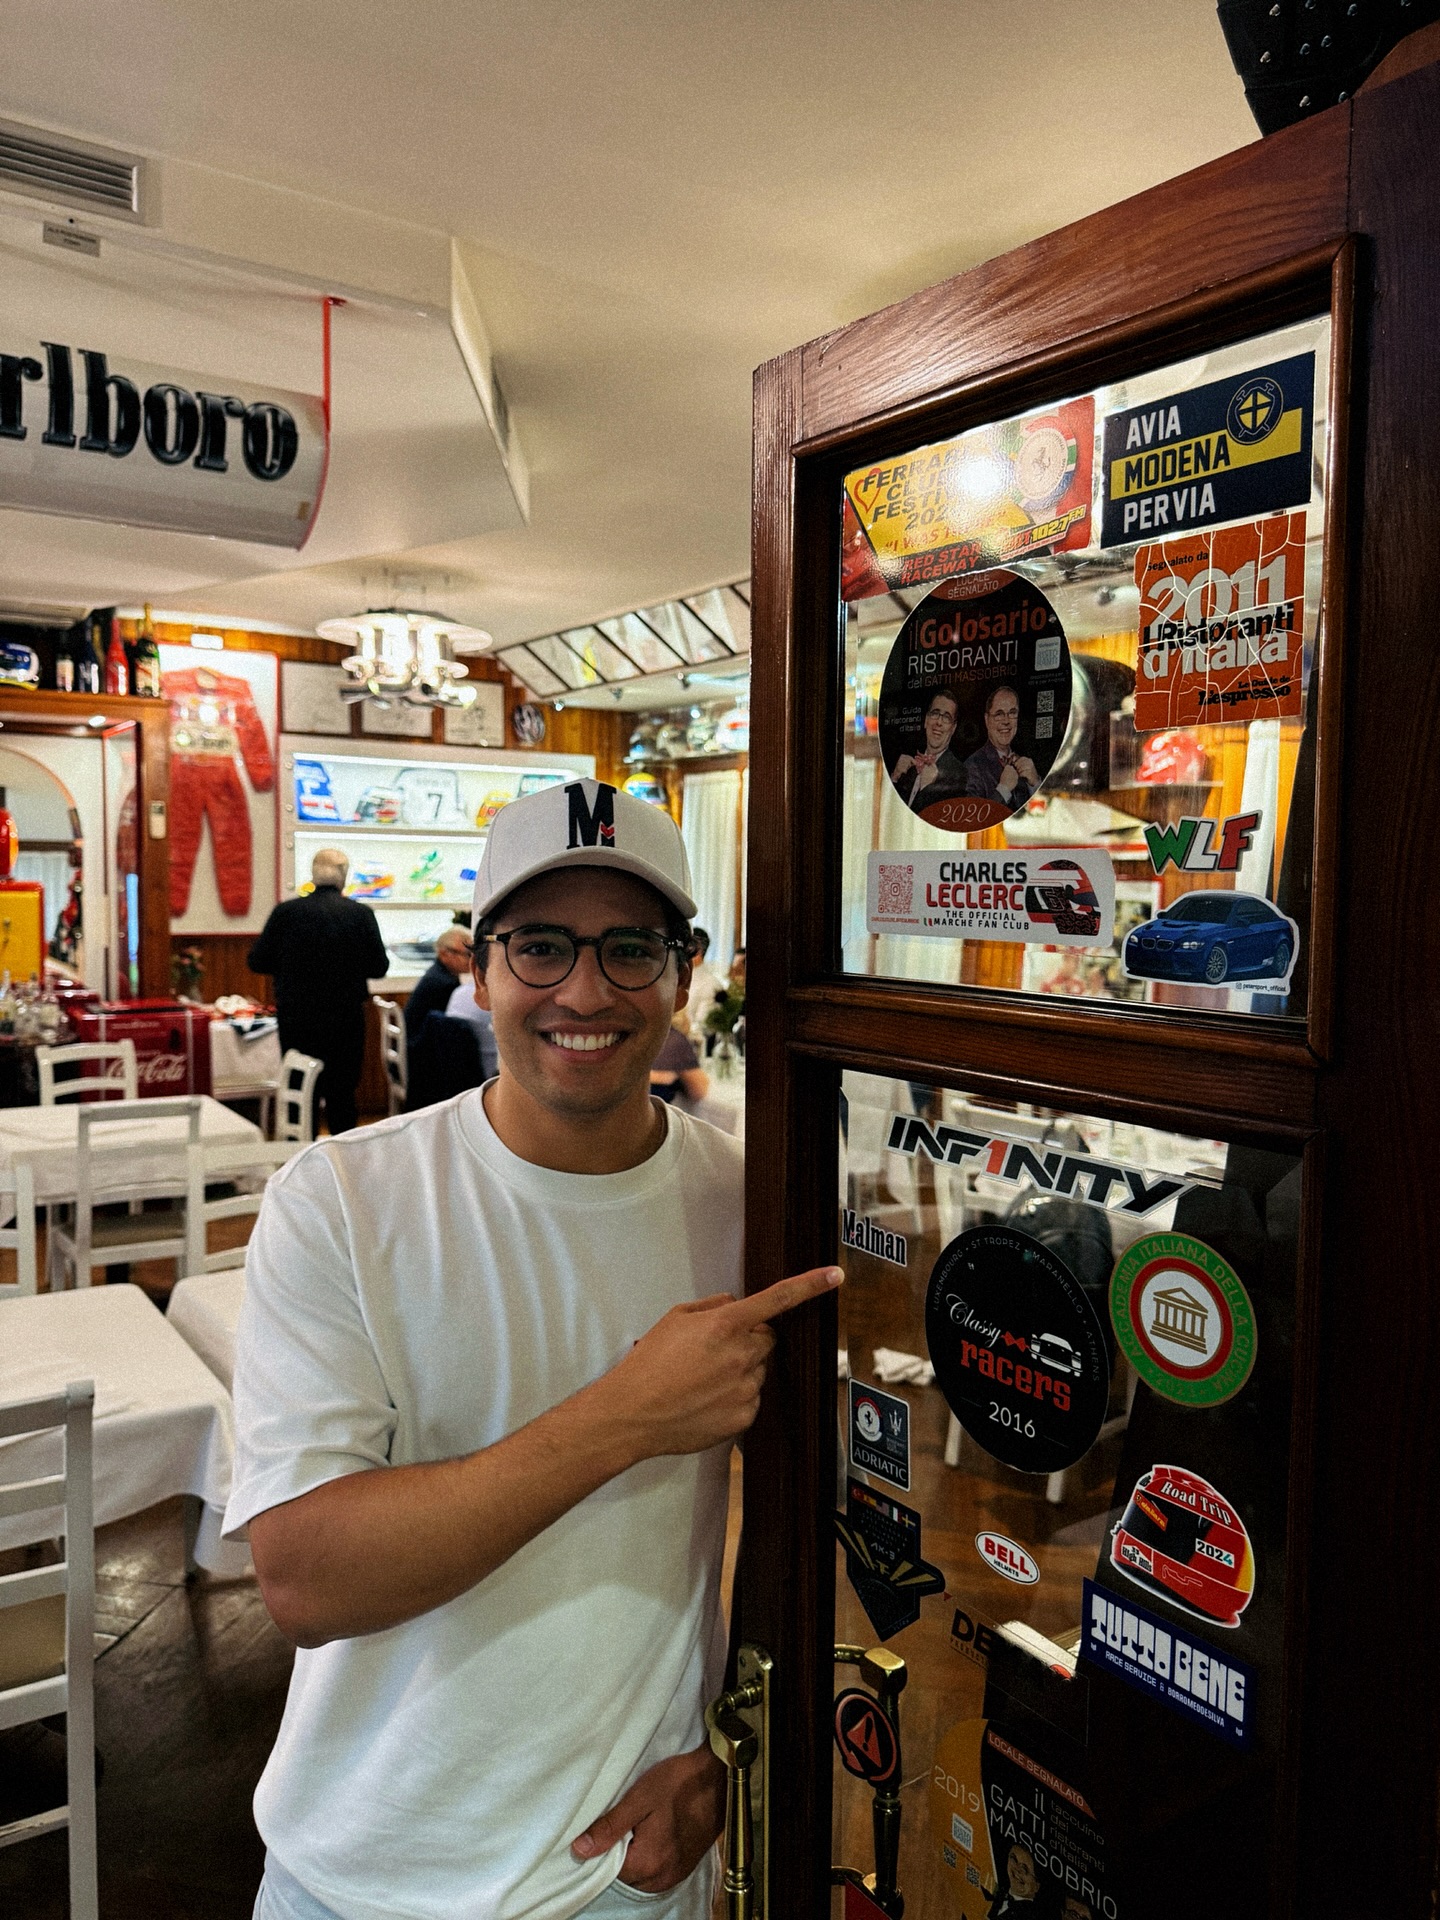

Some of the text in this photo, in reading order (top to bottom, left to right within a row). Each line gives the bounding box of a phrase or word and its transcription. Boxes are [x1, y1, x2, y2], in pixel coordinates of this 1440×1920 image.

[1126, 405, 1181, 450] AVIA
[862, 448, 962, 493] FERRAR
[1124, 434, 1231, 493] MODENA
[1124, 482, 1216, 534] PERVIA
[901, 555, 980, 585] RACEWAY
[902, 554, 938, 573] RED
[939, 542, 982, 564] STAR
[1196, 551, 1209, 561] da
[947, 580, 999, 600] SEGNALATO
[956, 572, 991, 587] LOCALE
[1147, 554, 1287, 640] 2011
[1157, 602, 1295, 652] Ristoranti
[908, 639, 1018, 677] RISTORANTI
[924, 672, 952, 688] GATTI
[954, 664, 1018, 682] MASSOBRIO
[1143, 632, 1288, 680] d'Italia
[937, 803, 991, 823] 2020
[1144, 813, 1258, 874] WLF
[939, 862, 1027, 883] CHARLES
[926, 882, 1024, 911] LECLERC
[946, 910, 1016, 921] THE OFFICIAL
[933, 918, 1029, 930] MARCHE FAN CLUB
[842, 1209, 906, 1266] Malman
[933, 1237, 1100, 1382] LUXEMBOURG ST TROPEZ MARANELLO ATHENS
[945, 1293, 1002, 1348] Classy
[1117, 1239, 1250, 1393] ACCADEMIA ITALIANA DELLA CUCINA
[960, 1338, 1072, 1412] racers
[988, 1401, 1036, 1438] 2016
[854, 1446, 907, 1481] ADRIATIC
[1160, 1481, 1232, 1525] Road Trip
[985, 1537, 1030, 1575] BELL
[994, 1560, 1019, 1577] HELMETS
[1196, 1540, 1233, 1566] 2024
[1091, 1593, 1246, 1723] TUTTO BENE
[1105, 1650, 1123, 1667] RACE
[1124, 1661, 1156, 1687] SERVICE
[934, 1765, 981, 1812] 2019
[989, 1732, 1084, 1807] LOCALE SEGNALATO
[990, 1783, 1045, 1840] GATTI
[1050, 1800, 1105, 1846] taccuino
[1050, 1814, 1069, 1833] dei
[990, 1807, 1117, 1920] MASSOBRIO
[1050, 1825, 1105, 1873] ristoranti
